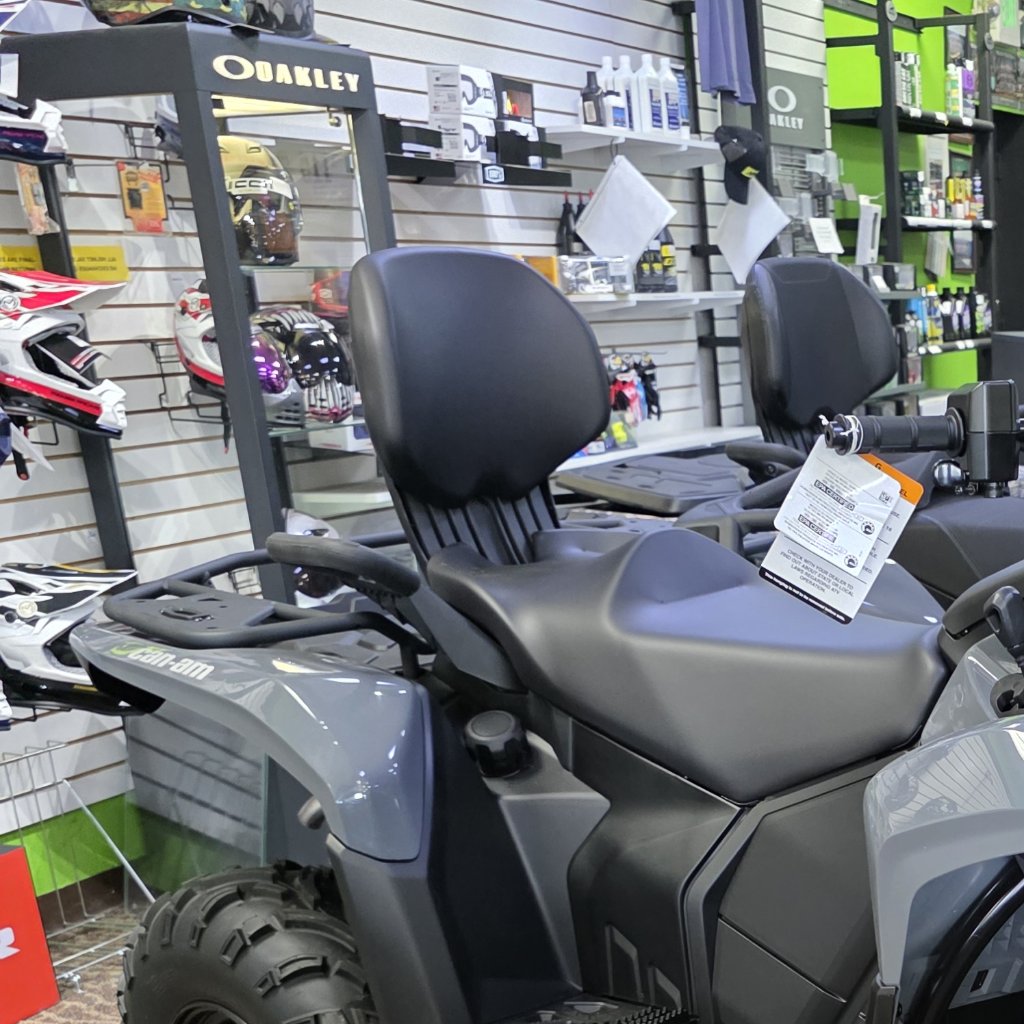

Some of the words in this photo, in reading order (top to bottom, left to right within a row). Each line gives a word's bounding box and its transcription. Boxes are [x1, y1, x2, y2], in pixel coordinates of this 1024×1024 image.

[769, 114, 804, 129] AKLEY
[829, 572, 847, 586] DEALER
[127, 647, 215, 681] can-am
